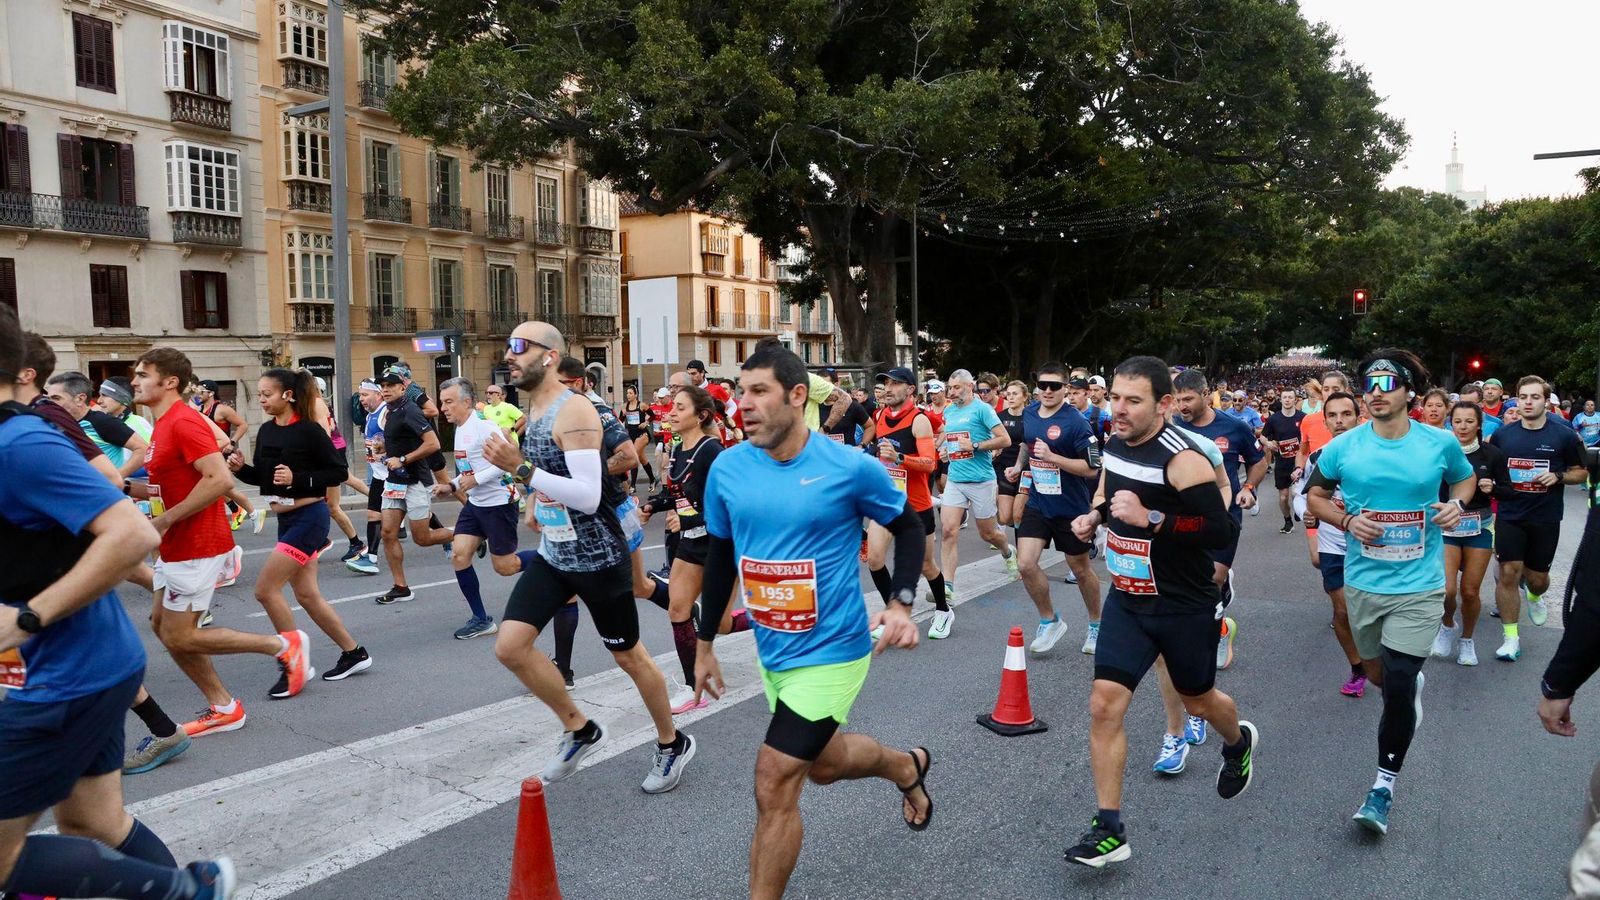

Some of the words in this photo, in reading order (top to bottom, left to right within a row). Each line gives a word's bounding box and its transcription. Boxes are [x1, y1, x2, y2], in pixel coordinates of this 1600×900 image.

[1377, 512, 1420, 522] GENERALI
[1113, 554, 1136, 570] 1583
[756, 564, 809, 576] GENERALI
[759, 586, 795, 600] 1953
